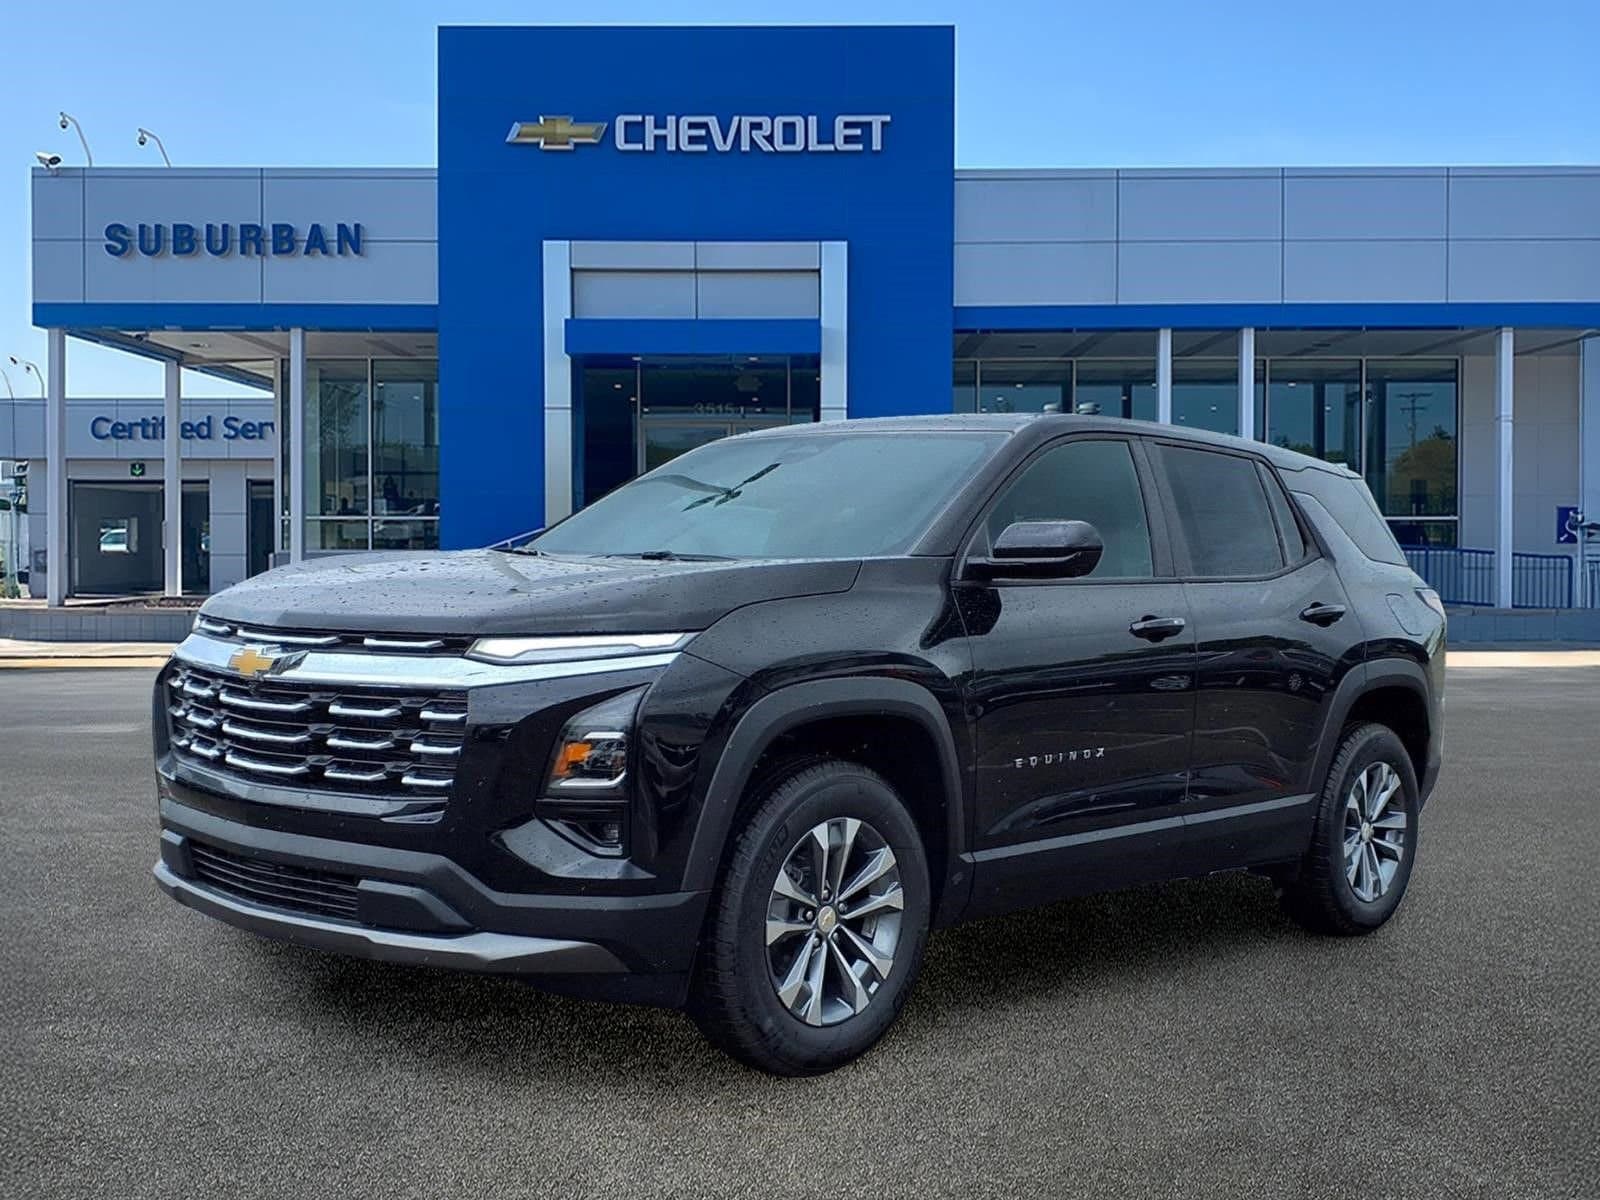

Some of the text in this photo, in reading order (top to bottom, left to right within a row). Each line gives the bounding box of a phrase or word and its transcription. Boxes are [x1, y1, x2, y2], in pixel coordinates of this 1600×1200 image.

[614, 114, 892, 153] CHEVROLET
[104, 222, 364, 258] SUBURBAN
[90, 415, 212, 440] Certifed
[1014, 747, 1105, 769] EQUINOX
